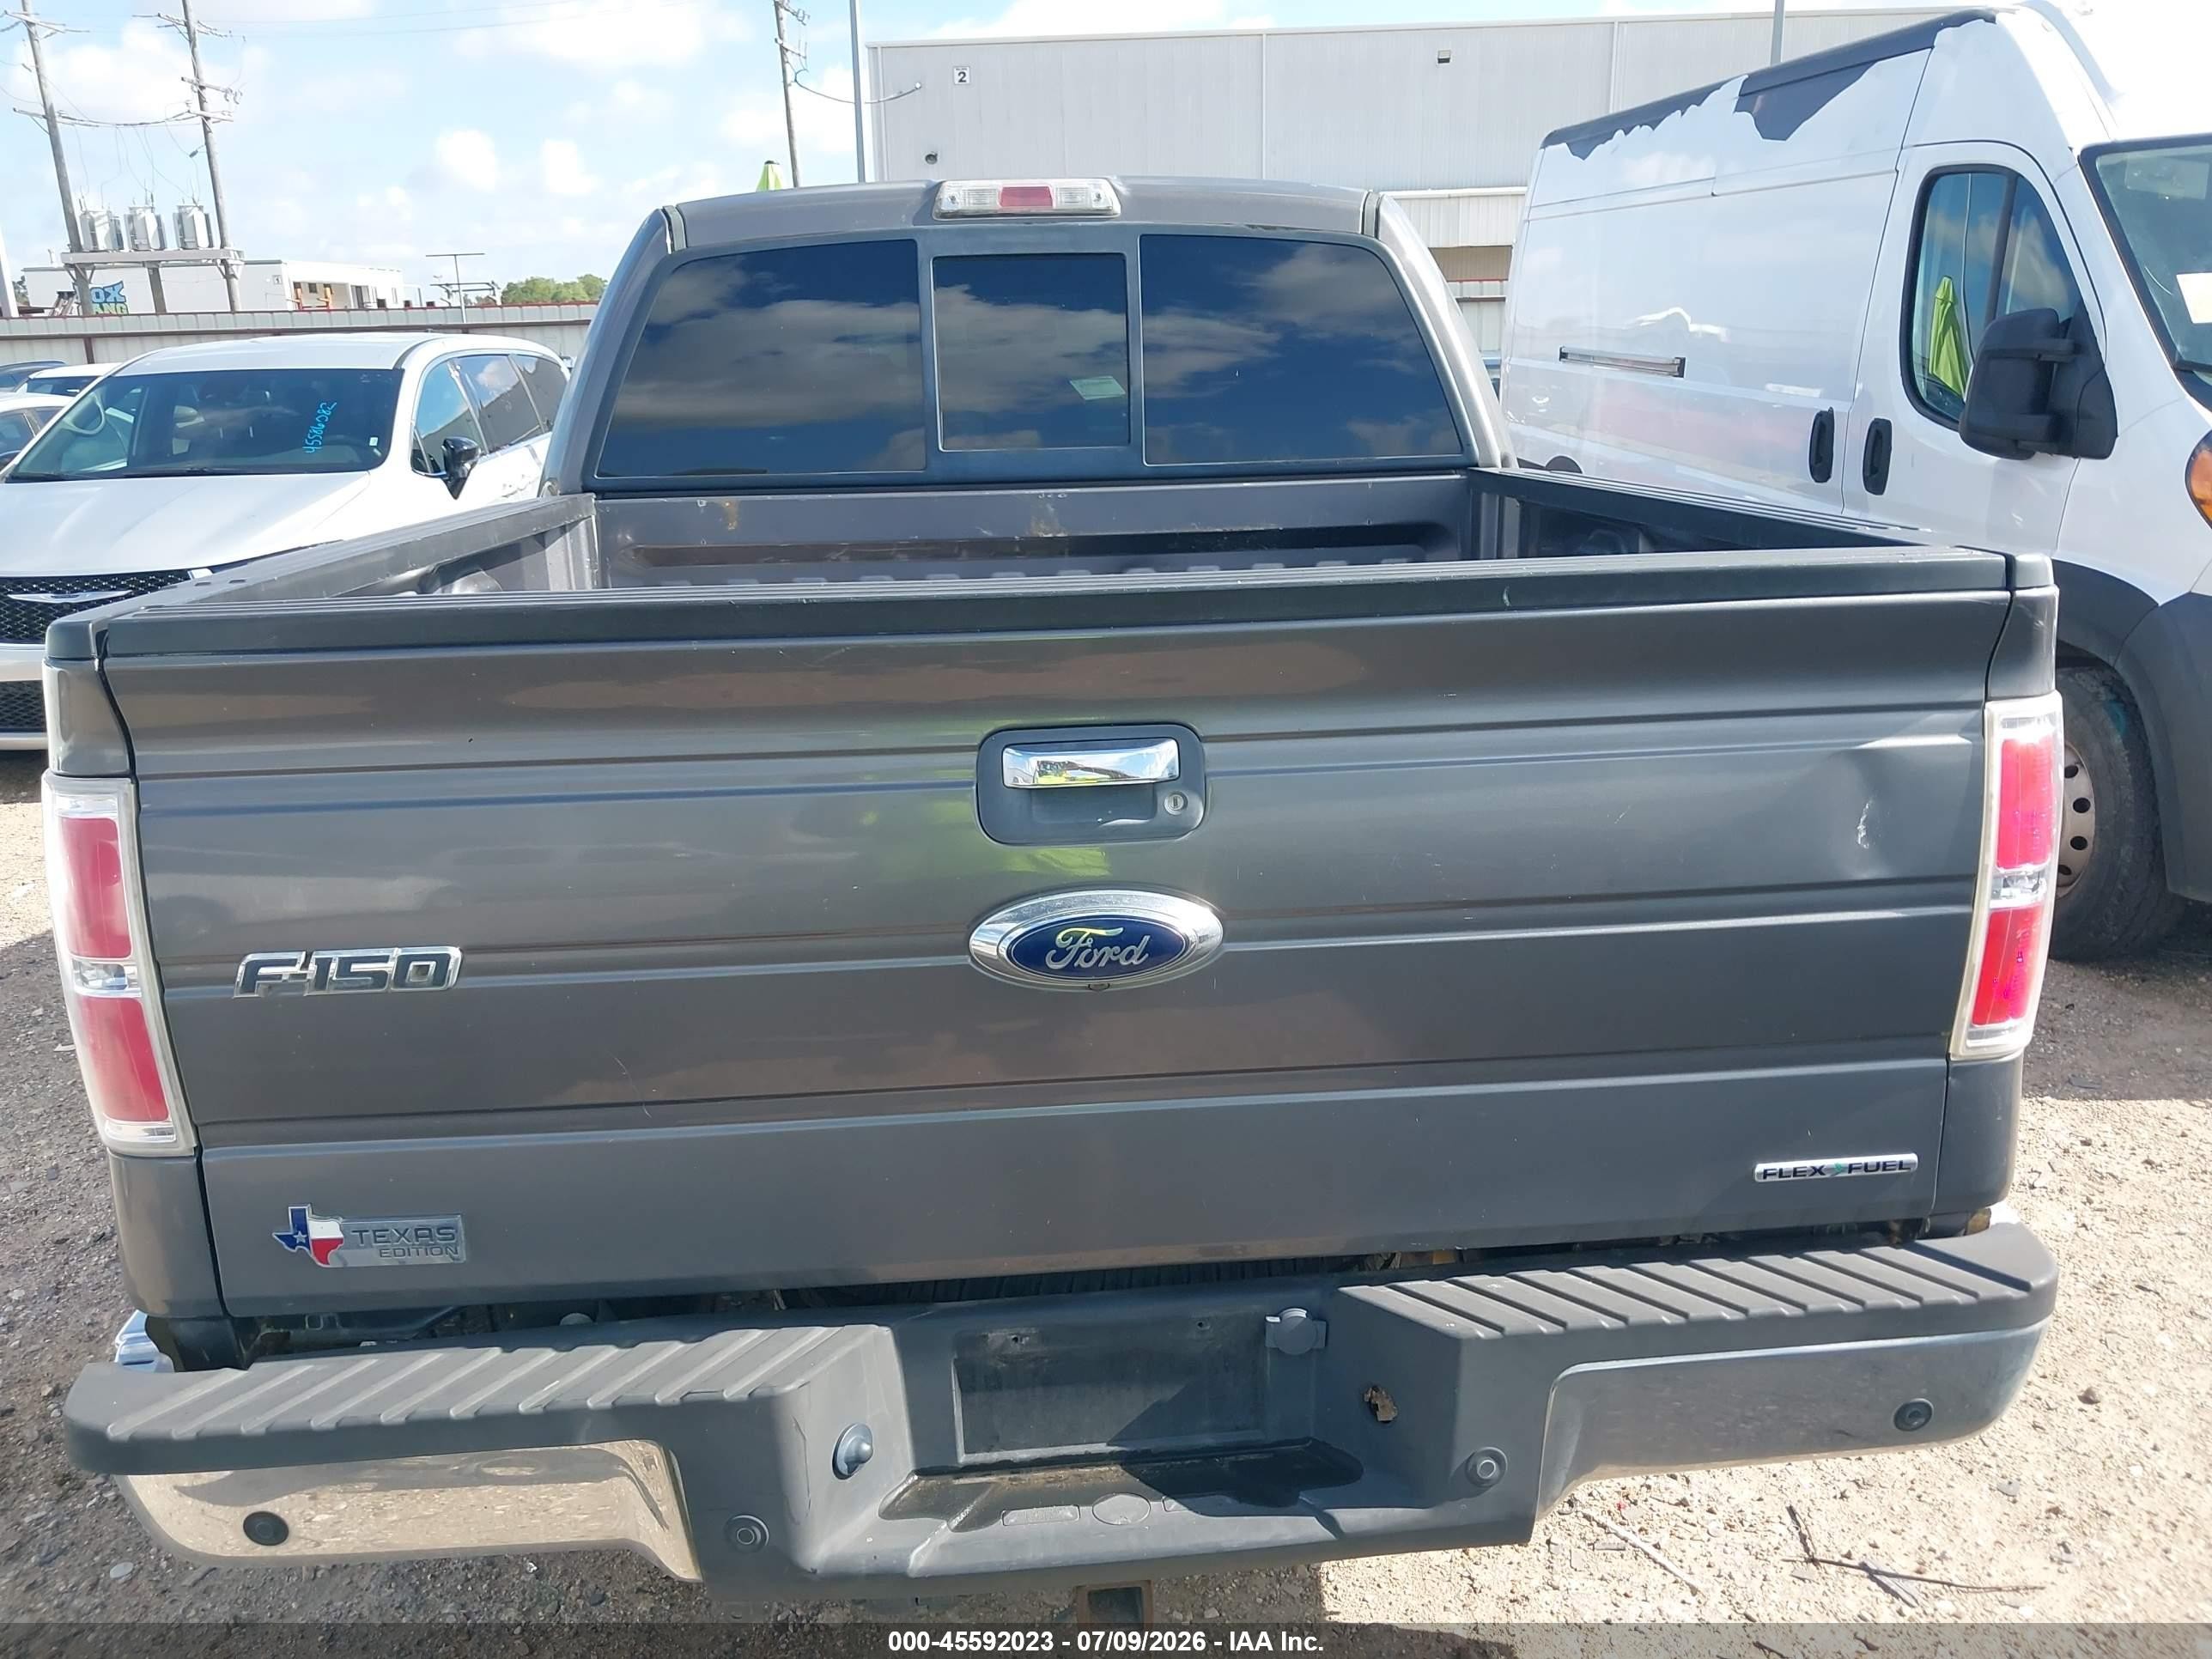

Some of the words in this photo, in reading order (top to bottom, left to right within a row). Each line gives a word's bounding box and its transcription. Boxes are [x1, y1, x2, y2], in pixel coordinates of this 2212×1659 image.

[957, 71, 967, 82] 2
[302, 401, 337, 453] 45586082
[1045, 927, 1152, 969] Ford
[233, 945, 463, 999] F-150
[1762, 1165, 1826, 1180] FLEX
[1848, 1159, 1911, 1174] FUEL
[350, 1226, 457, 1246] TEXAS
[379, 1245, 459, 1259] EDITION
